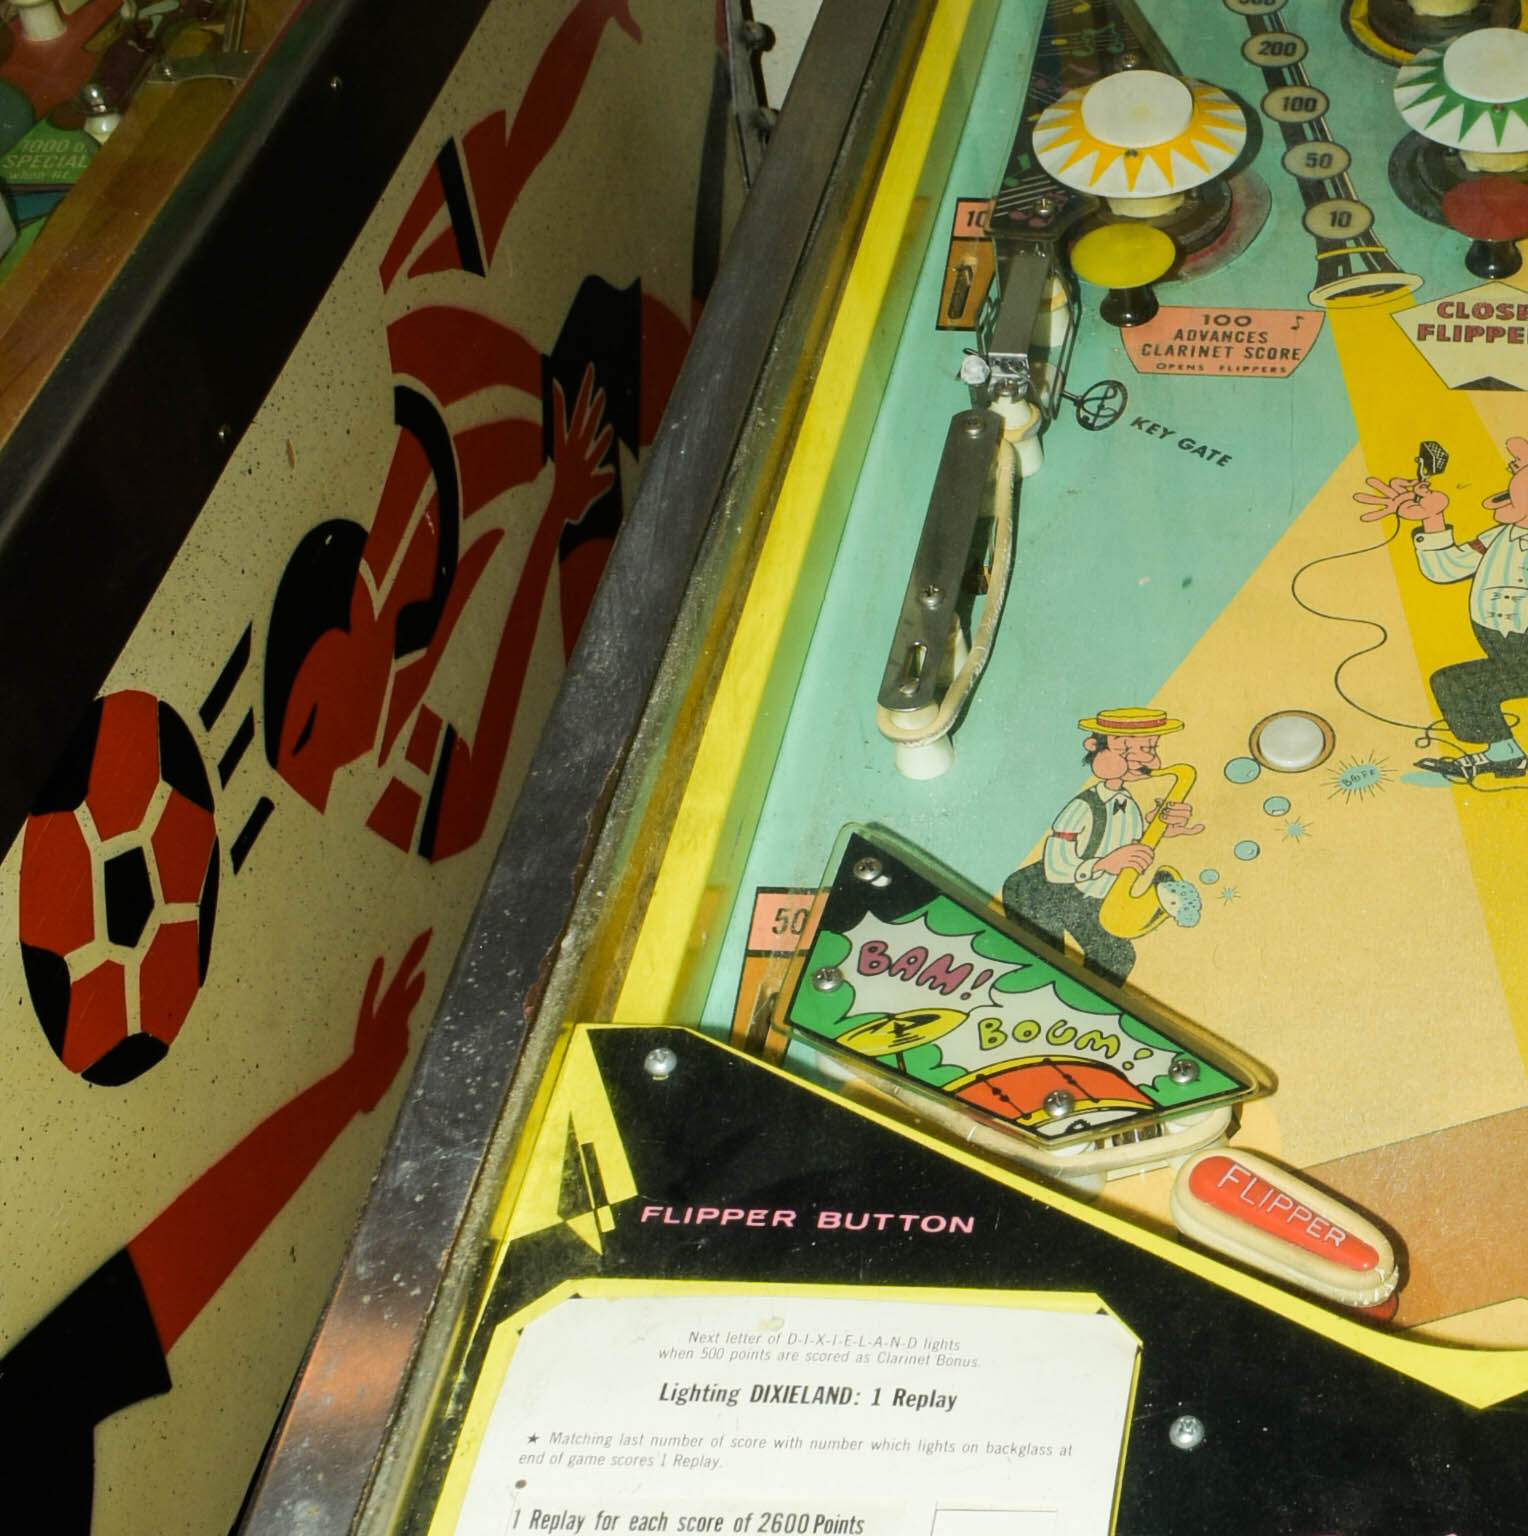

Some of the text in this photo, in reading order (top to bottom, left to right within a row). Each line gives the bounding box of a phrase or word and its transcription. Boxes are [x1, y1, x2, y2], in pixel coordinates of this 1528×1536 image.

[1259, 41, 1298, 59] 200
[1282, 95, 1318, 114] 100
[1306, 152, 1333, 170] 50
[1329, 210, 1352, 229] 10
[1203, 314, 1252, 327] 100
[1173, 328, 1269, 343] ADVANCES
[1141, 343, 1302, 361] CLARINET SCORE
[1156, 362, 1287, 374] OPENS FLIPPERS
[1130, 416, 1232, 468] KEY GATE
[771, 907, 808, 936] 50
[858, 939, 994, 1002] BAM!
[977, 1015, 1154, 1073] BOUM!
[1215, 1163, 1347, 1249] FLIPPER
[640, 1205, 975, 1234] FLIPPER BUTTON
[688, 1331, 722, 1345] Next
[725, 1332, 763, 1346] letter
[768, 1332, 782, 1346] of
[923, 1337, 962, 1353] lights
[658, 1347, 694, 1360] when
[699, 1347, 725, 1361] 500
[729, 1348, 772, 1363] points
[777, 1350, 800, 1362] are
[804, 1350, 850, 1364] scored
[855, 1353, 871, 1364] as
[876, 1351, 931, 1366] Clarinet
[658, 1381, 958, 1412] Lighting DIXIELAND: 1 Replay
[548, 1431, 1073, 1458] Matching last number of score with number which lights on backglass at
[518, 1452, 545, 1465] end
[549, 1452, 564, 1465] of
[567, 1453, 606, 1468] game
[610, 1454, 654, 1467] scores
[512, 1508, 865, 1535] 1 Replay for each score of 2600 Points
